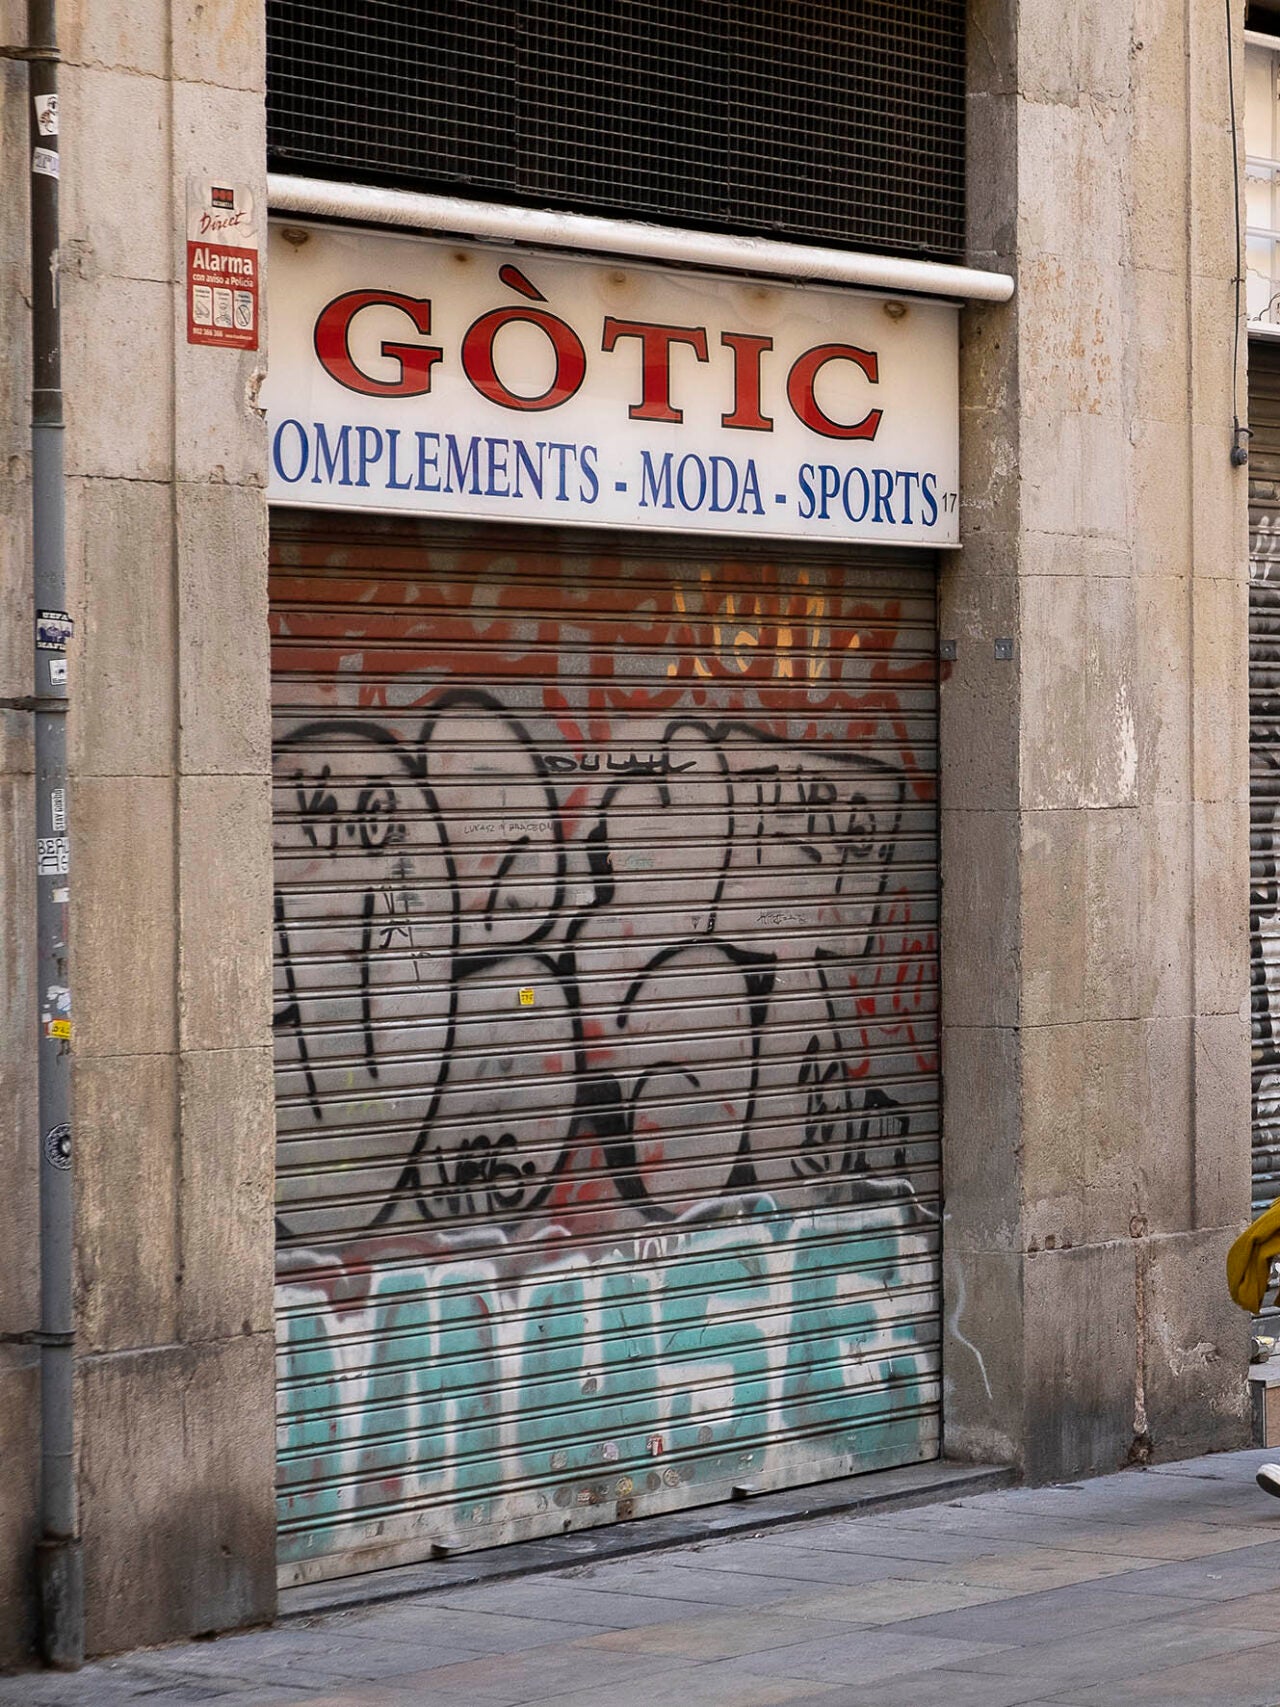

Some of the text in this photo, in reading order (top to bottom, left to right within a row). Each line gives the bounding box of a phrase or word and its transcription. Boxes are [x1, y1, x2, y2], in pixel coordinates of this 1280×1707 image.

[200, 212, 247, 234] Direct
[192, 247, 254, 275] Alarma
[192, 273, 205, 282] con
[206, 274, 224, 285] aviso
[313, 263, 884, 442] GÒTIC
[272, 419, 600, 504] OMPLEMENTS
[638, 450, 766, 516] MODA
[797, 462, 939, 527] SPORTS
[941, 492, 958, 513] 17
